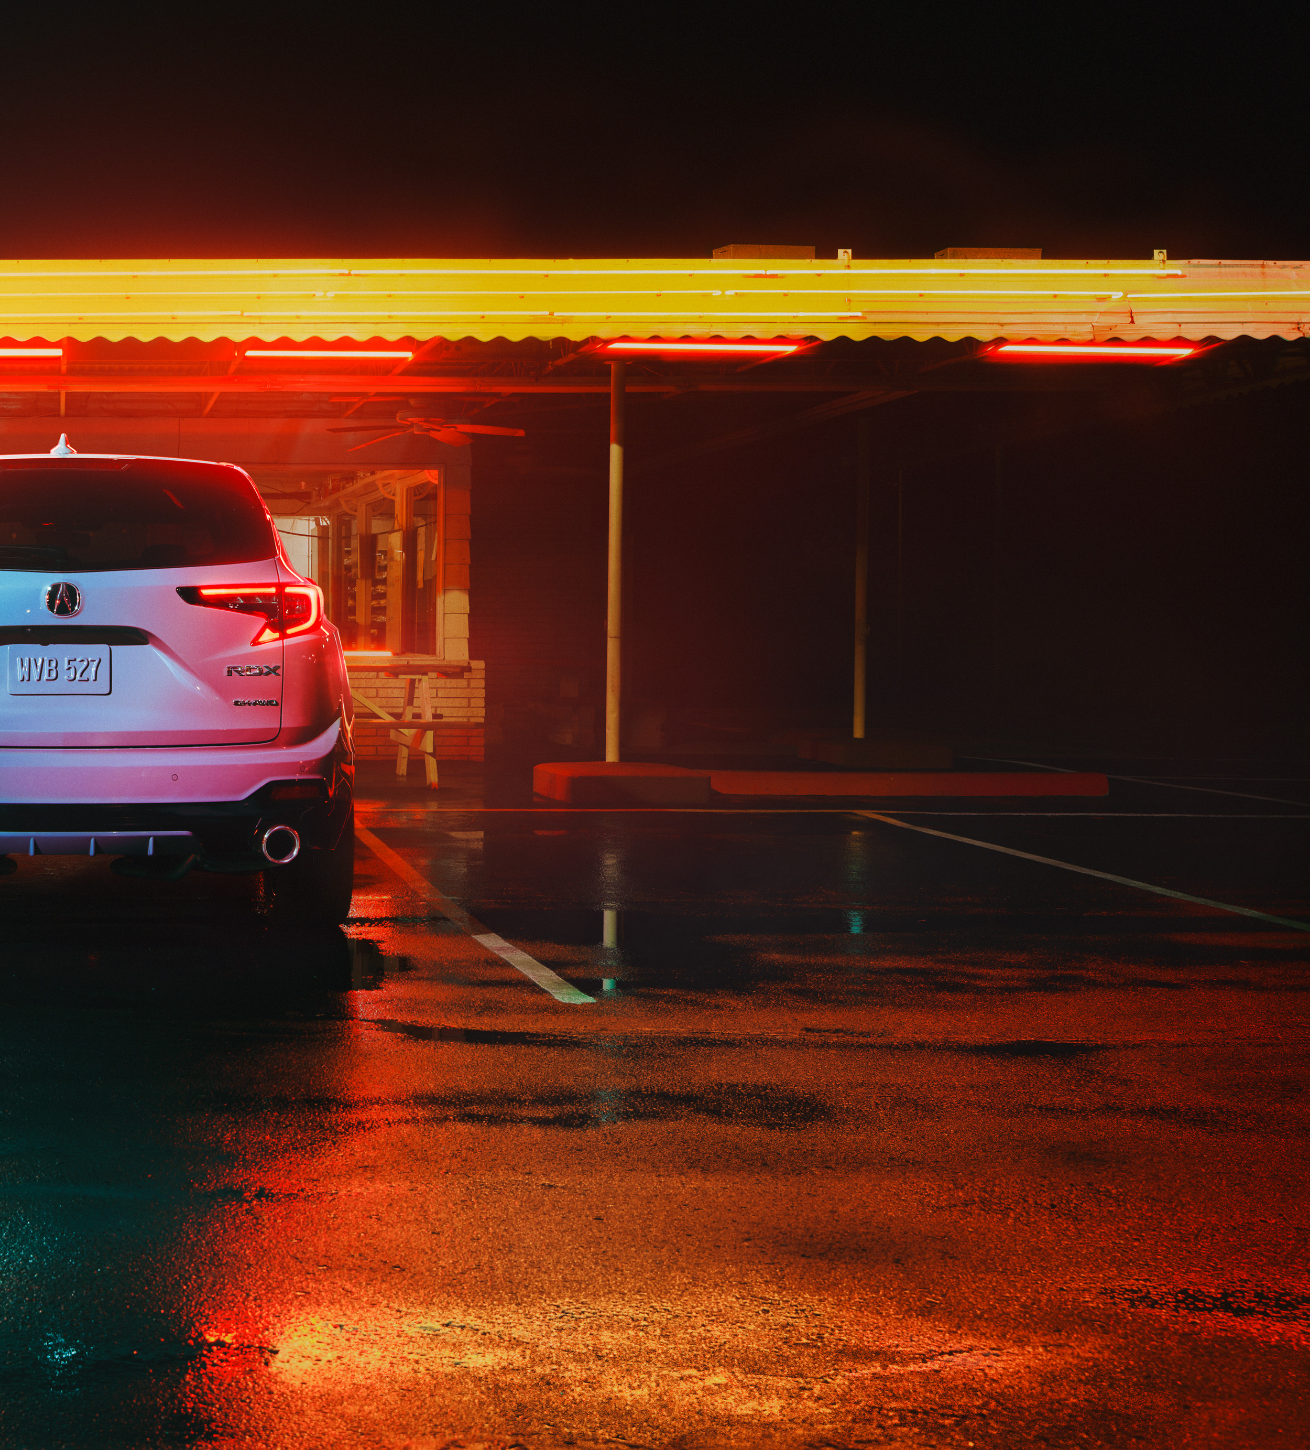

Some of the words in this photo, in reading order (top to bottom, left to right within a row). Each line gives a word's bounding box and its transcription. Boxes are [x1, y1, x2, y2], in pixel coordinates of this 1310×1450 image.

[16, 657, 58, 682] WVB
[64, 657, 102, 682] 527
[225, 664, 281, 676] RDX
